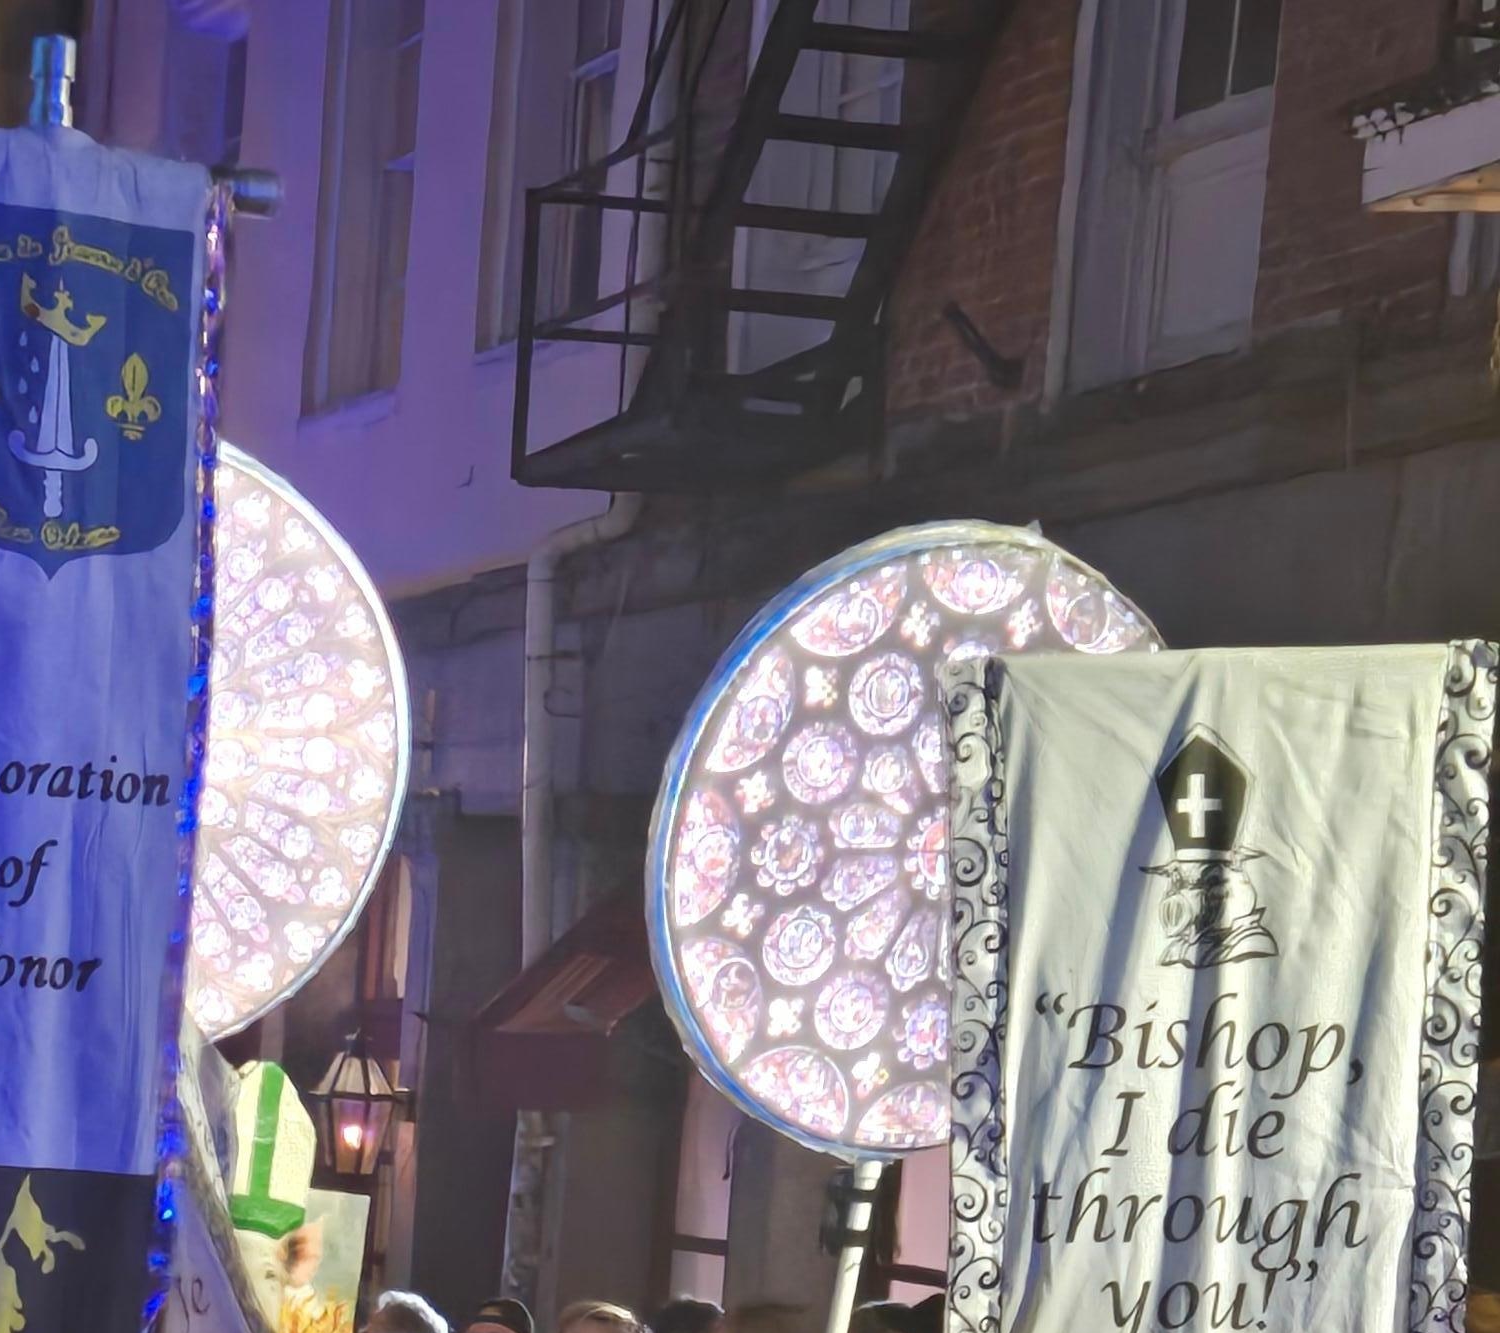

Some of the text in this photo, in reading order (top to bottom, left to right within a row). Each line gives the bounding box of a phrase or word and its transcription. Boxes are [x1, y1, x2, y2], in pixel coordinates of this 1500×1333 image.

[1034, 991, 1364, 1099] “Bishop,
[1102, 1081, 1286, 1159] I die
[1032, 1167, 1368, 1279] through
